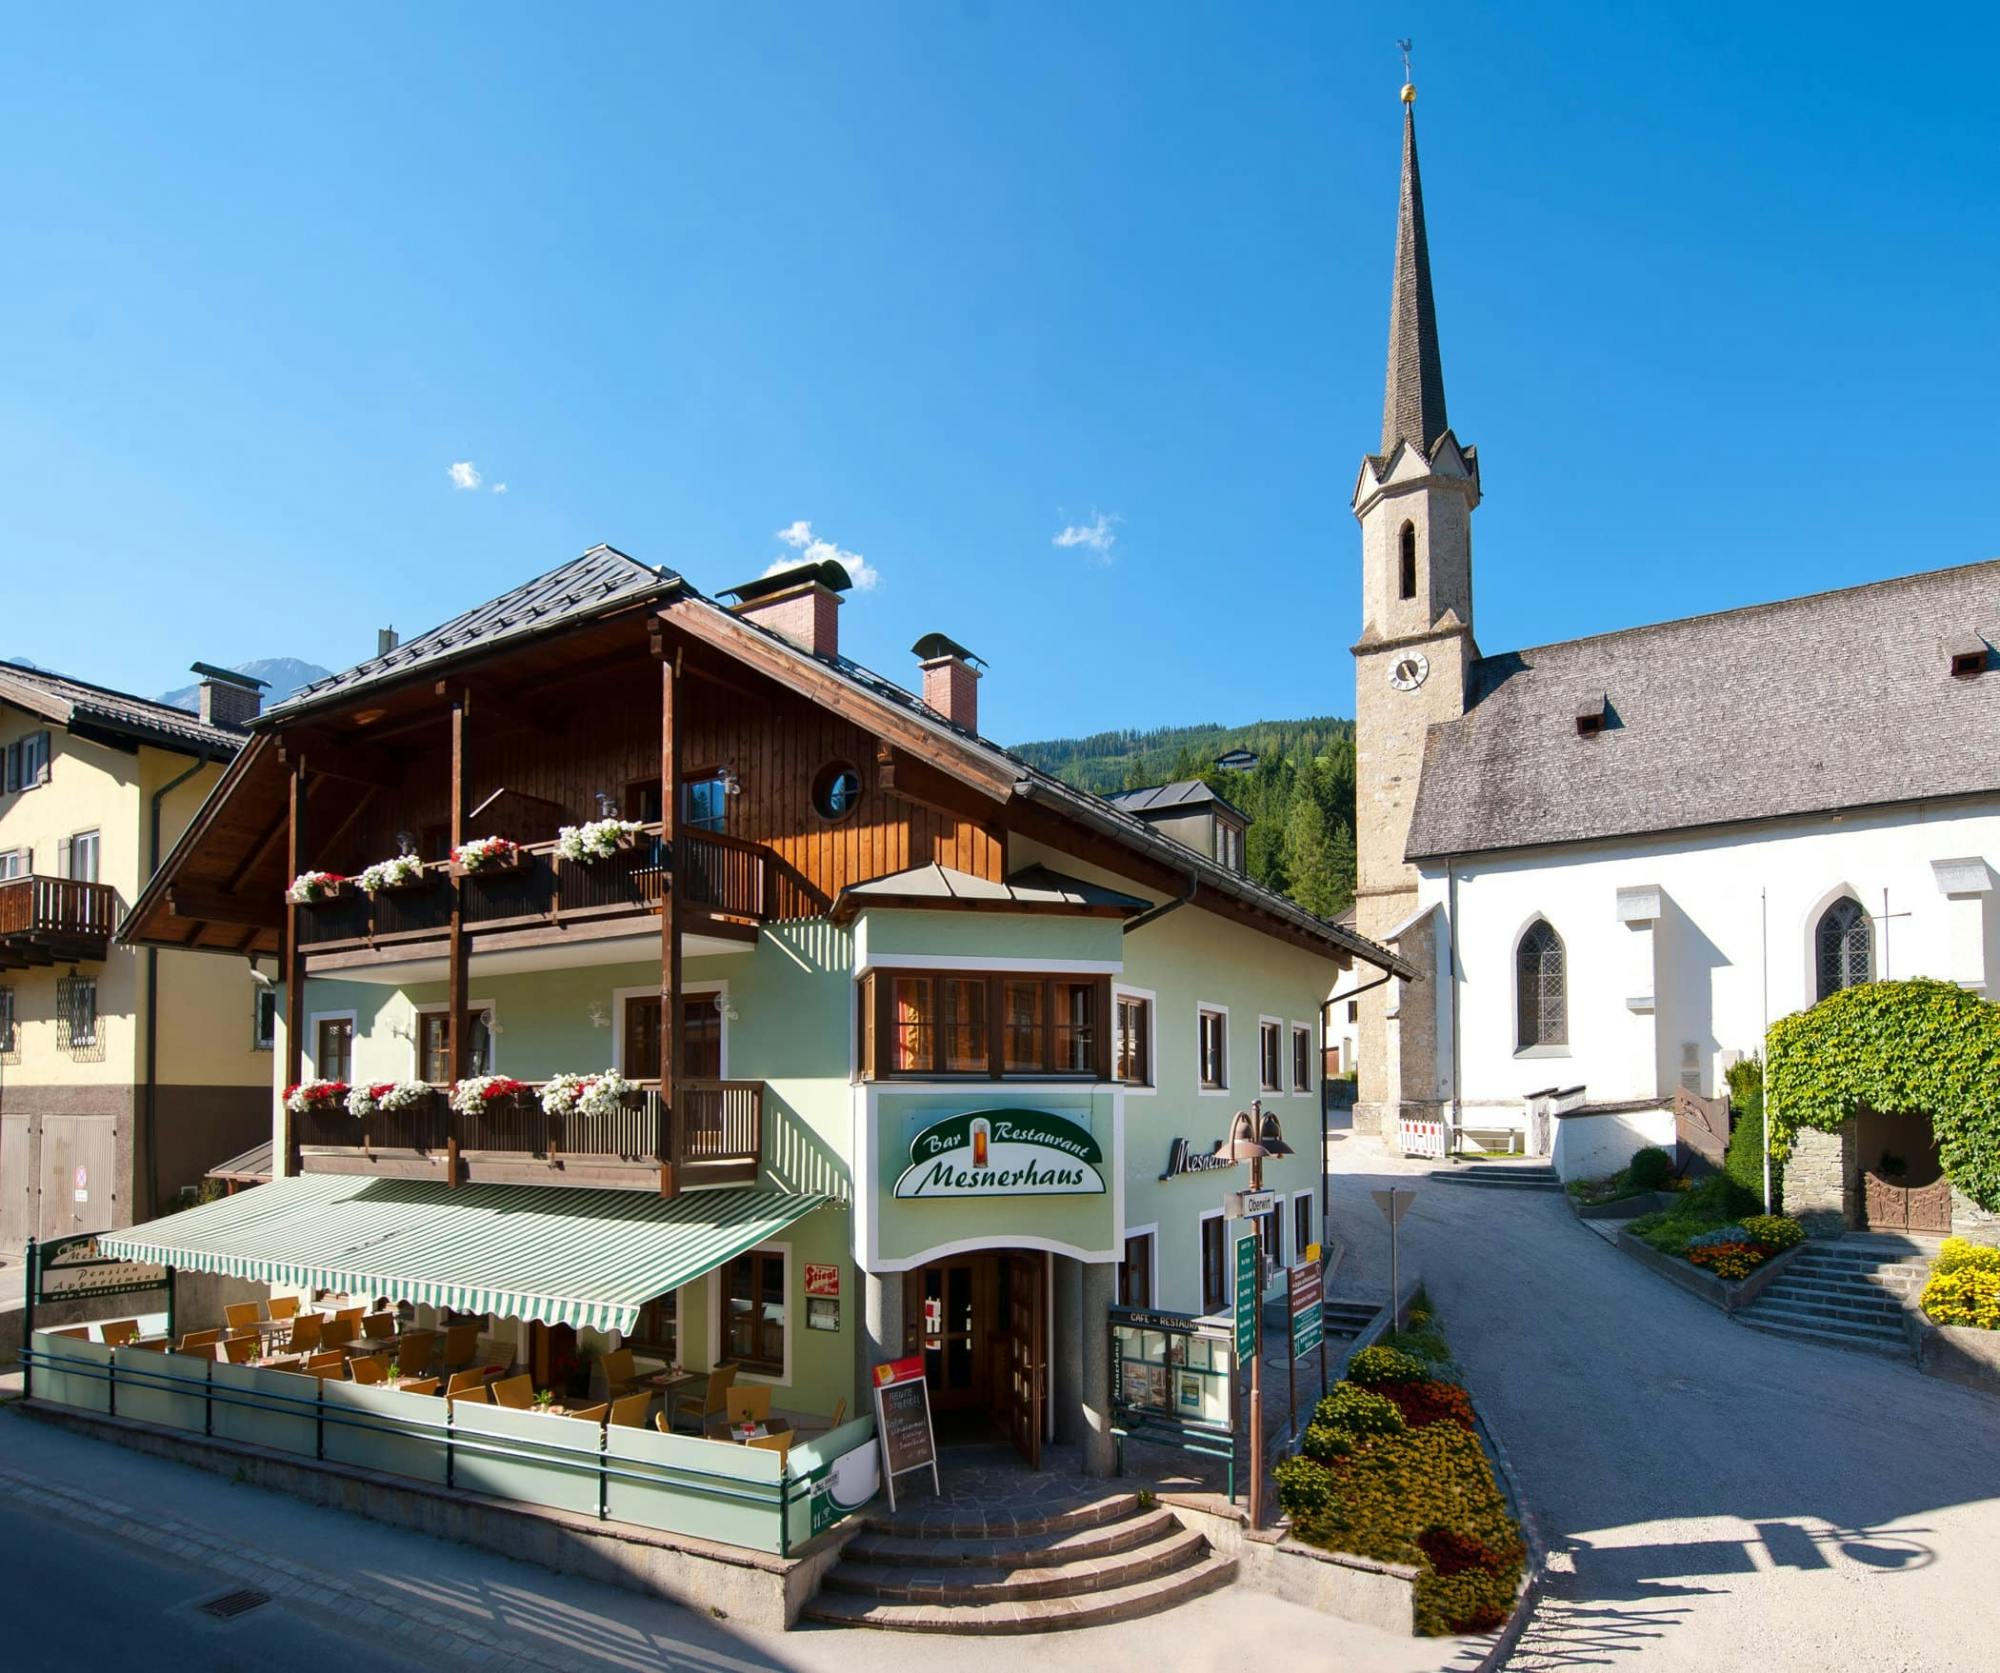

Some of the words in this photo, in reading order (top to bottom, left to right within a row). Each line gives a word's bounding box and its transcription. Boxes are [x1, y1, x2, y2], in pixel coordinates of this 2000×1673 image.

[923, 1133, 961, 1153] Bar
[994, 1121, 1089, 1158] Restaurant
[914, 1158, 1084, 1195] Mesnerhaus
[1248, 1197, 1272, 1212] Oberwirt
[53, 1272, 160, 1293] Appartement
[76, 1266, 139, 1281] Pension
[1130, 1311, 1150, 1324] CAFE
